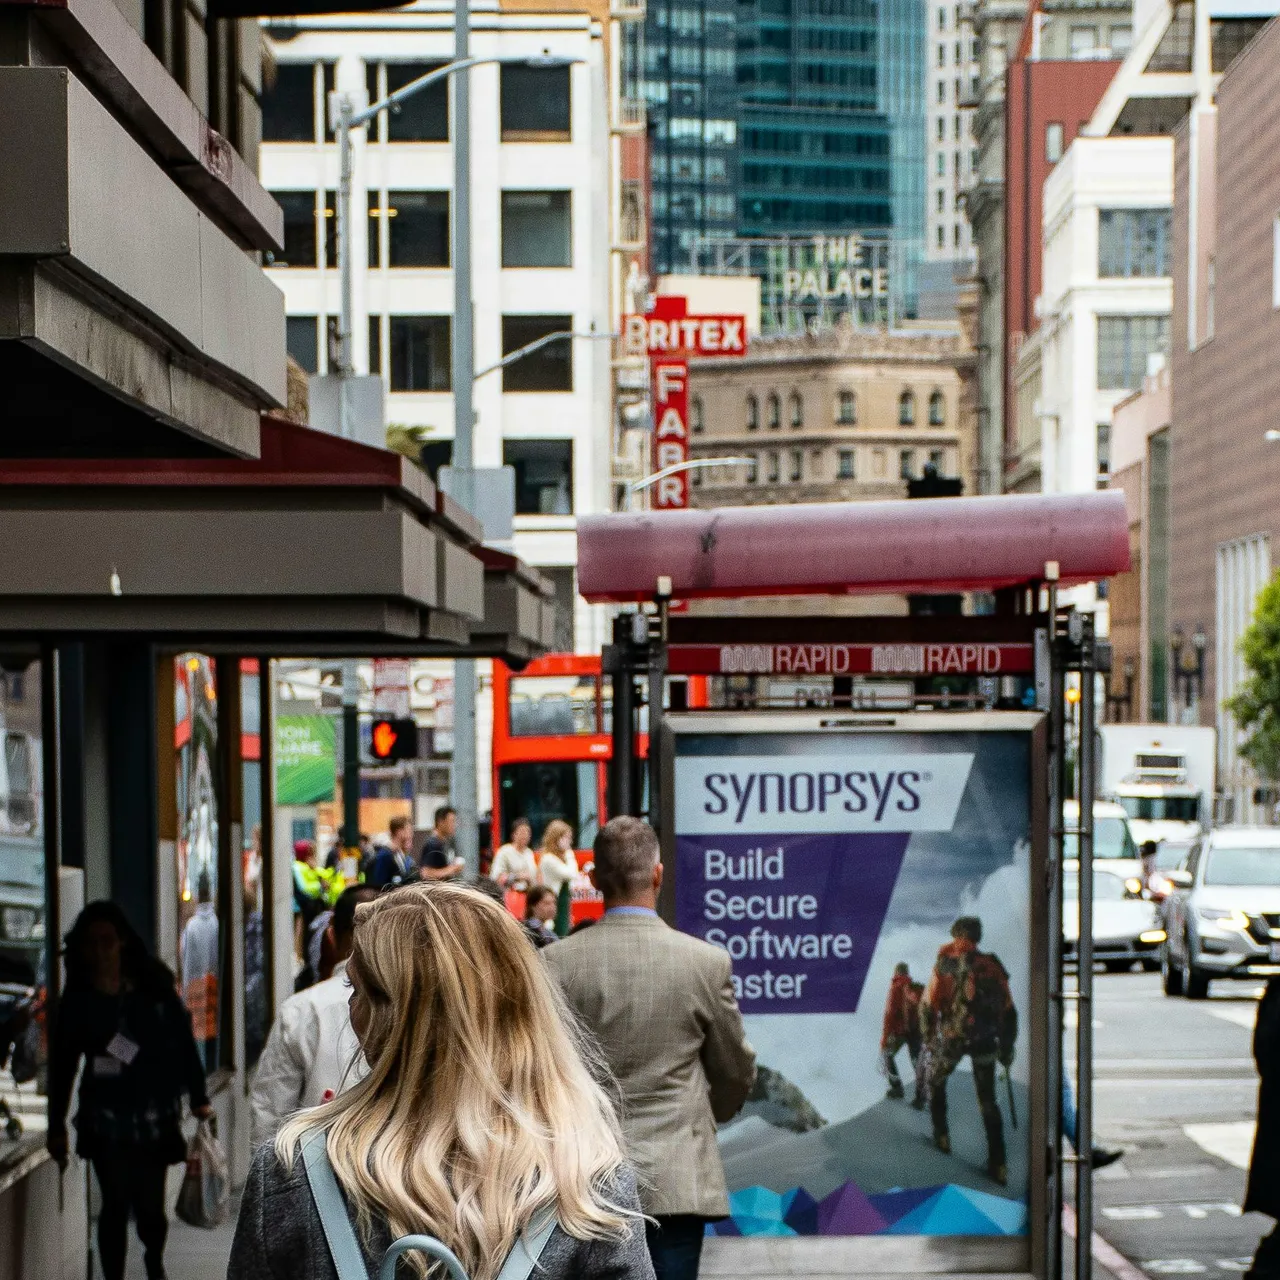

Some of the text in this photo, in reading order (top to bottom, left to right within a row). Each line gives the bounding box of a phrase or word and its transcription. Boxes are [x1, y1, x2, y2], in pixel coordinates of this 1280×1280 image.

[812, 235, 864, 264] THE
[783, 268, 890, 300] PALACE
[625, 316, 743, 351] BRITEX
[776, 645, 850, 672] RAPID
[927, 645, 1002, 672] RAPID
[704, 771, 921, 823] SYNOPSYS
[704, 847, 785, 881] Build
[704, 888, 818, 921] Secure
[705, 926, 854, 960] Software
[730, 969, 809, 999] aster
